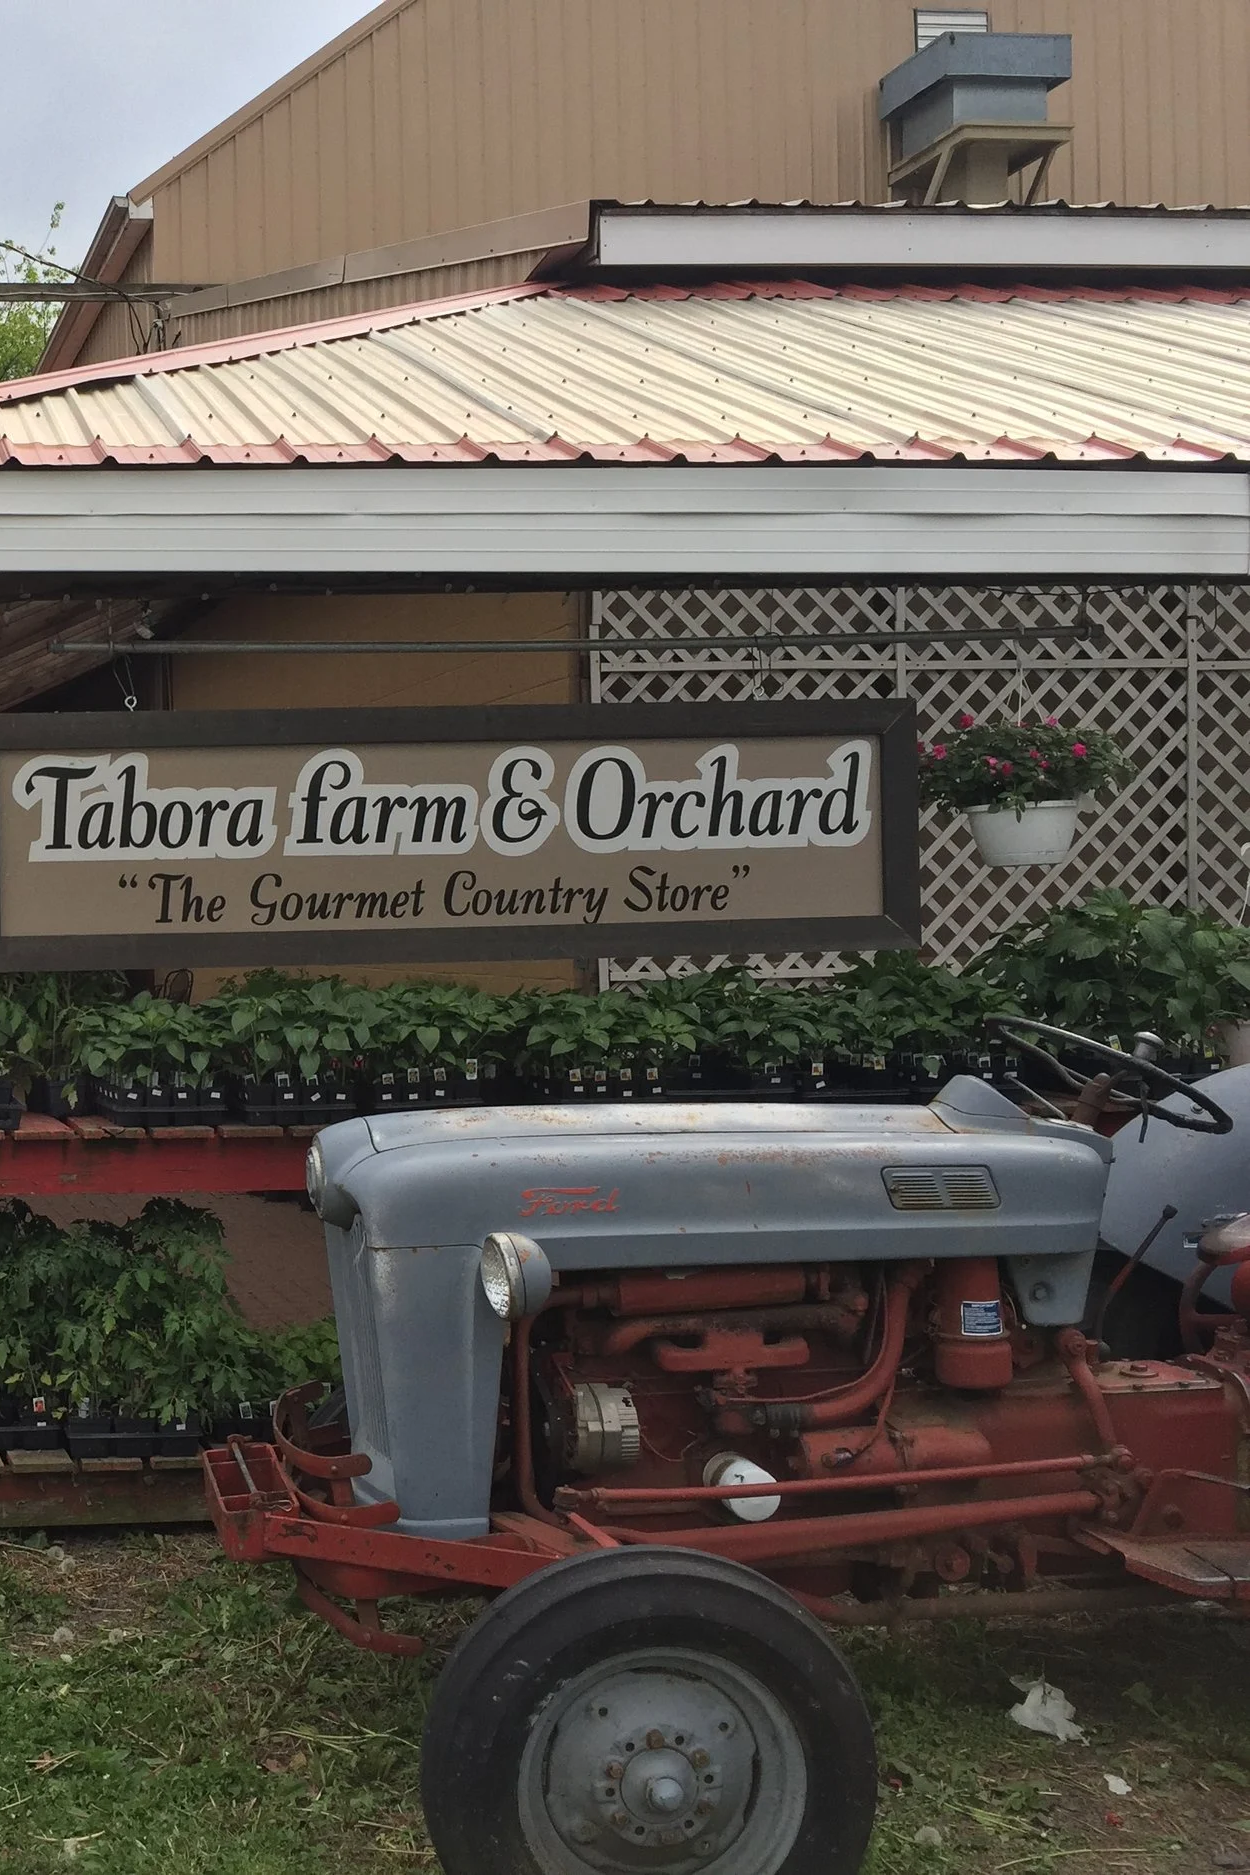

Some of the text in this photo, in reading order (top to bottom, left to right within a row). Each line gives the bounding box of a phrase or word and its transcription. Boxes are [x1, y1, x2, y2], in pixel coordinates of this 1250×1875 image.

[25, 751, 859, 850] Tabora farm & Orchard
[250, 873, 425, 926] Gourmet
[443, 870, 608, 924] Country
[519, 1186, 621, 1217] Ford
